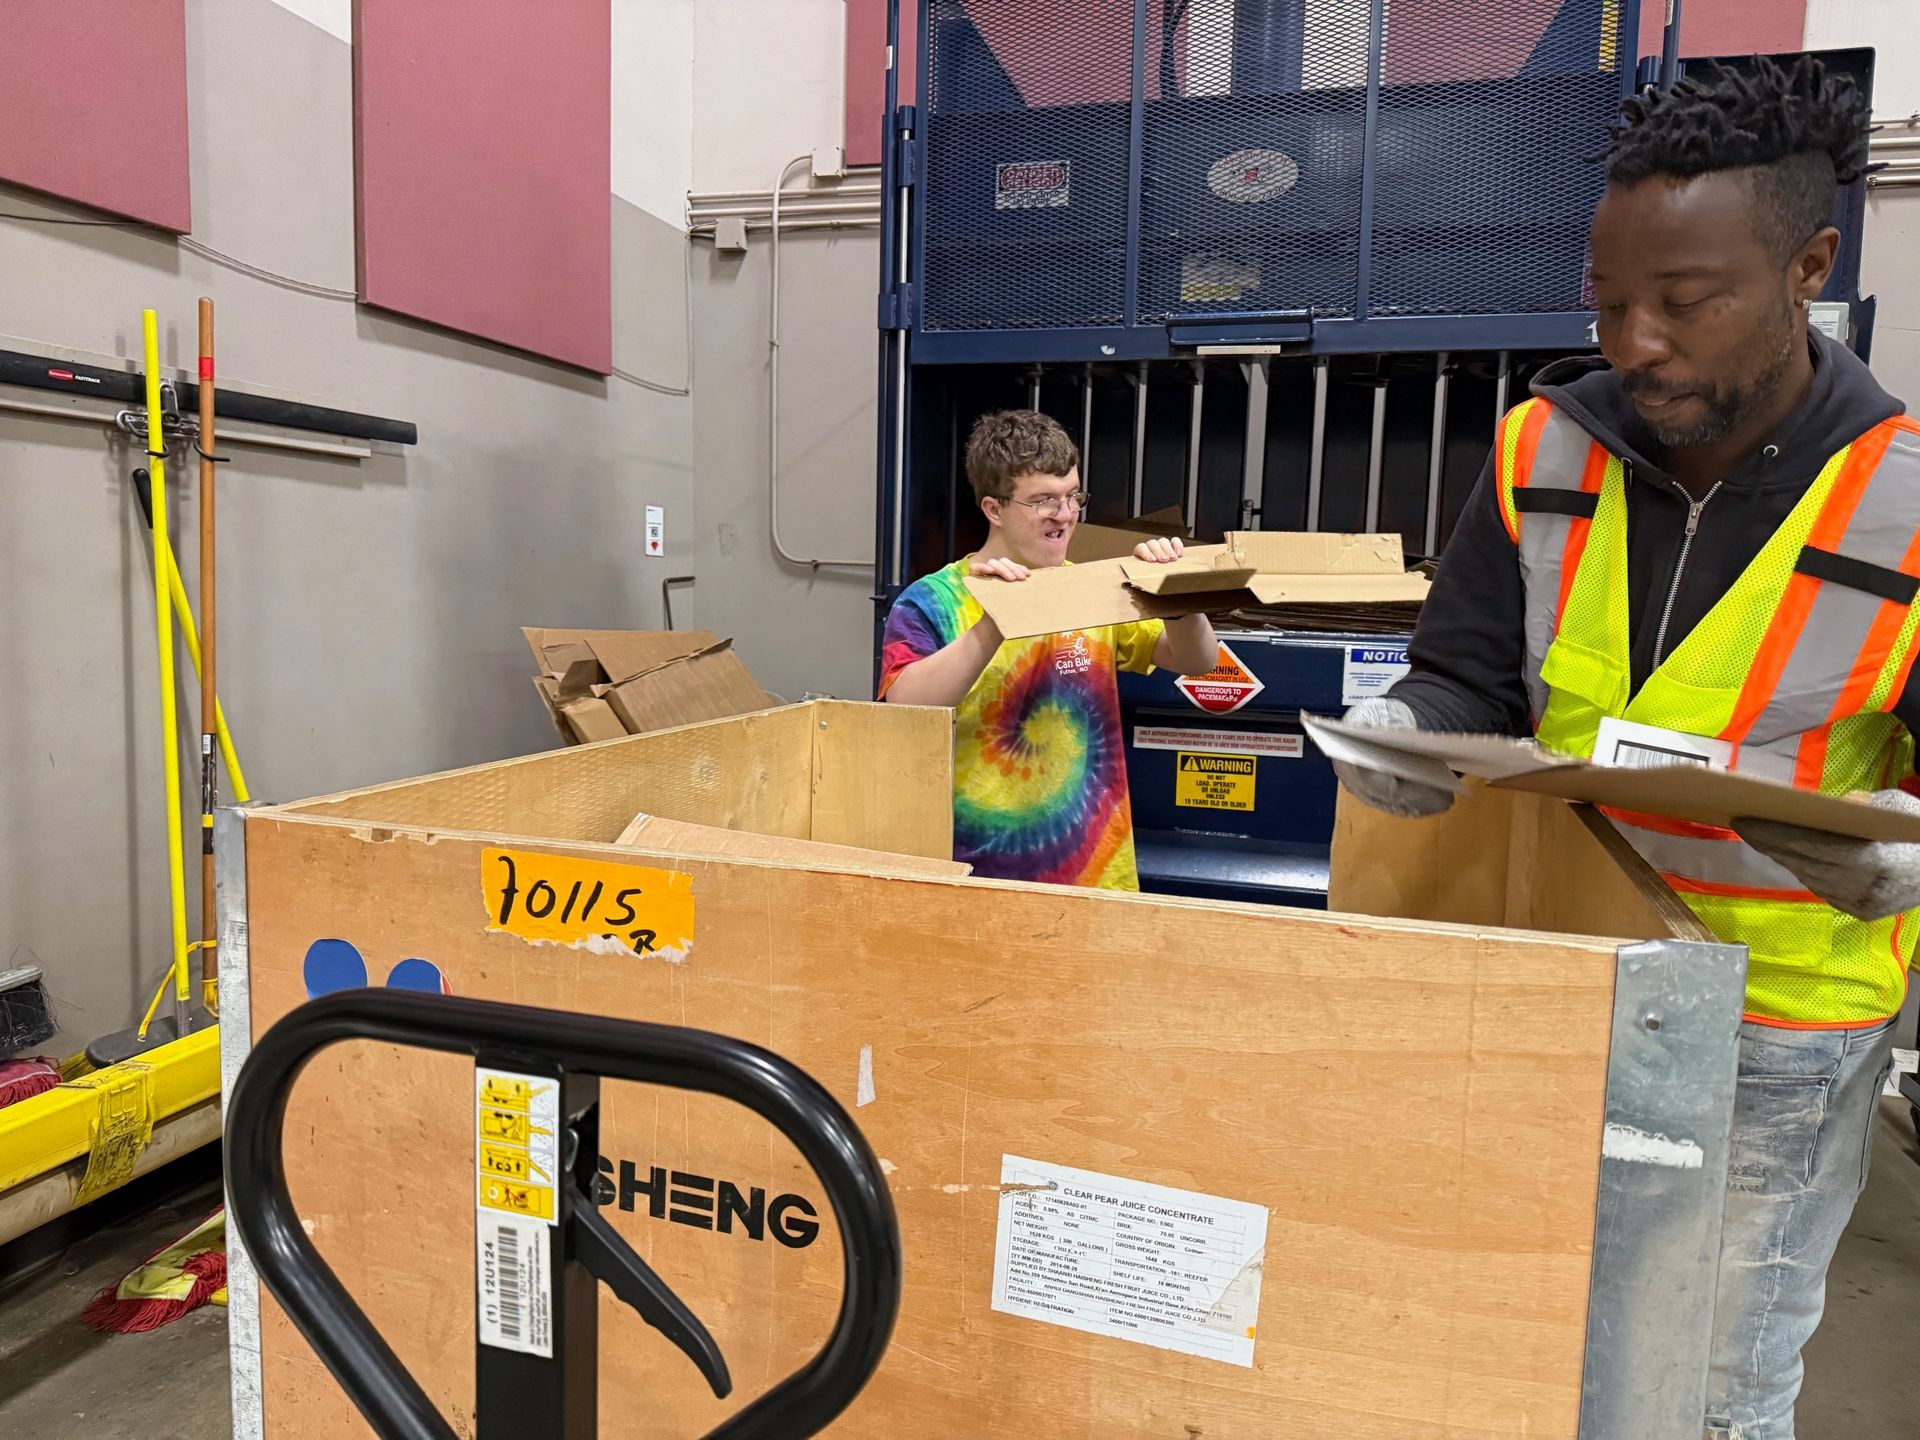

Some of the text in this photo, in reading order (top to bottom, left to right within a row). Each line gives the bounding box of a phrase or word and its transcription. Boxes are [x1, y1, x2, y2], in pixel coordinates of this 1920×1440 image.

[1363, 651, 1410, 662] NOTIC
[1210, 665, 1239, 676] RNING
[1195, 686, 1232, 695] DANGEROUS
[1200, 759, 1251, 773] WARNING
[1192, 798, 1209, 806] YEARS
[497, 856, 642, 926] 70115
[1063, 1187, 1215, 1225] CLEAR PEAR JUICE CONCENTRATE
[1079, 1214, 1098, 1222] CITRIC
[1118, 1212, 1145, 1222] PACKAGE
[1116, 1232, 1143, 1242] COUNTRY
[1077, 1241, 1104, 1251] GALLONS
[1116, 1242, 1135, 1250] GROSS
[484, 1242, 496, 1296] 12U124
[519, 1263, 527, 1298] 12U124
[1010, 1260, 1037, 1270] SUPPLIED
[1073, 1274, 1102, 1284] HAISHENG
[1103, 1280, 1123, 1289] FRESH
[1124, 1284, 1140, 1292] FRUIT
[1142, 1288, 1158, 1296] JUICE
[1113, 1271, 1131, 1279] SHELF
[1165, 1282, 1190, 1291] MONTHS
[1008, 1295, 1031, 1304] HYGIENE
[1126, 1302, 1144, 1310] FRESH
